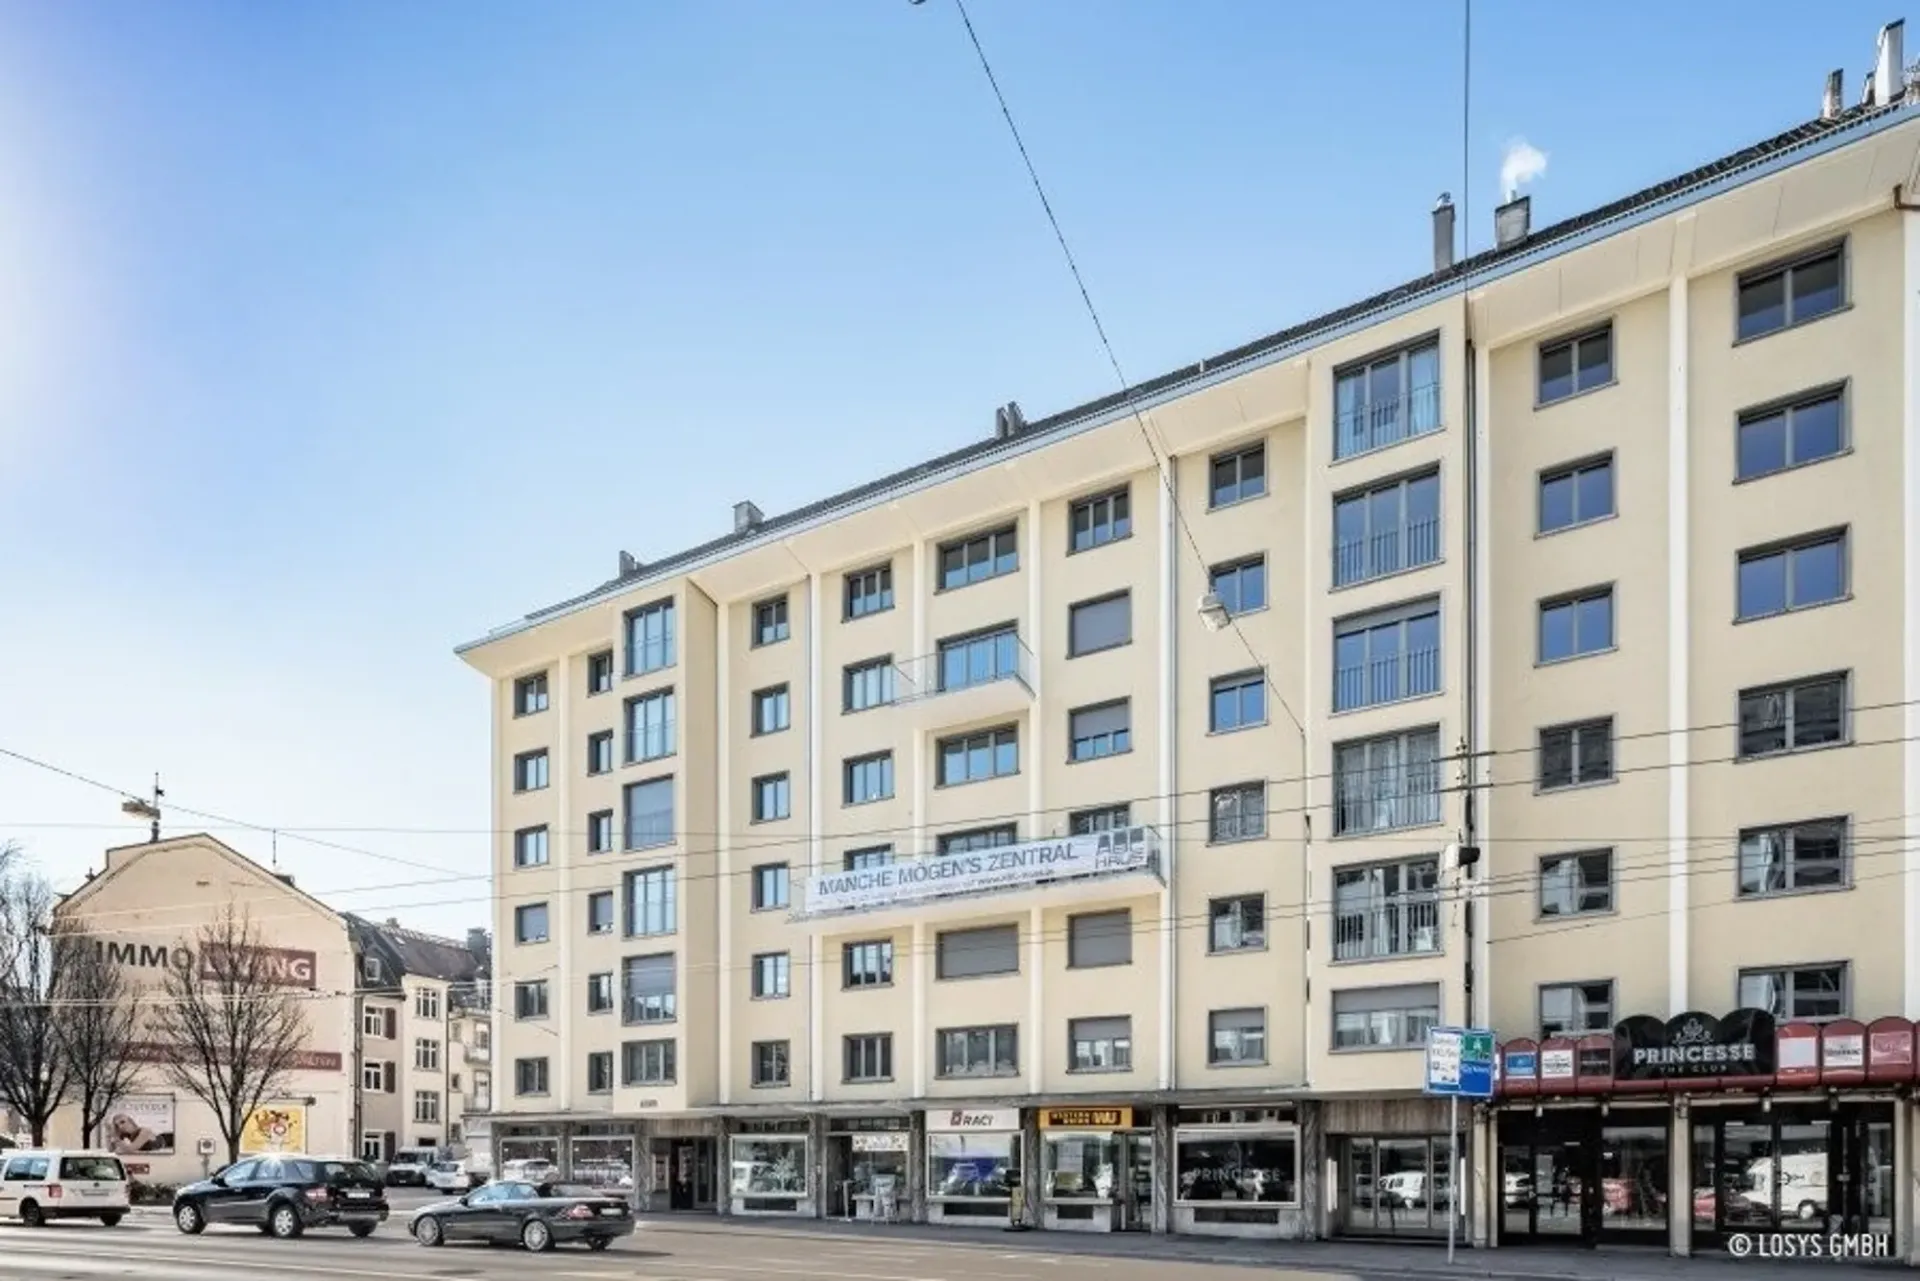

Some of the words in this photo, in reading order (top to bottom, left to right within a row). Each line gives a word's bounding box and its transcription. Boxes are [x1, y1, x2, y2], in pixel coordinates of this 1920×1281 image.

[819, 869, 894, 896] MANCHE
[987, 842, 1079, 872] ZENTRAL
[1632, 1043, 1756, 1065] PRINCESSE
[1193, 1167, 1281, 1182] PRINCESE
